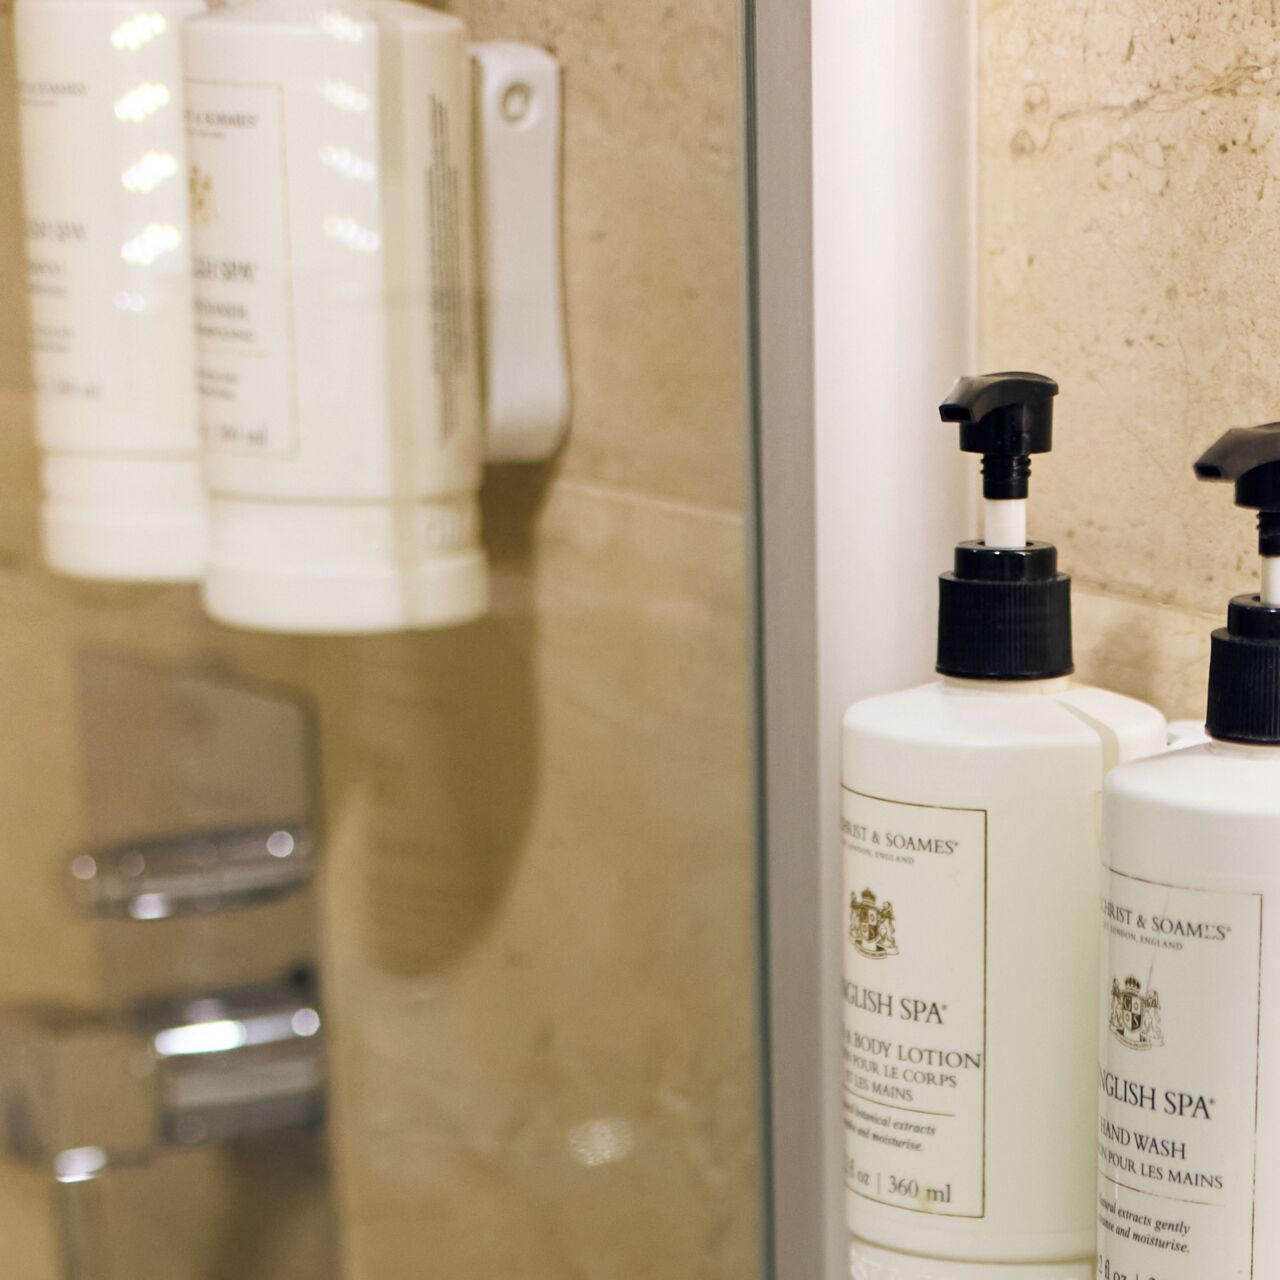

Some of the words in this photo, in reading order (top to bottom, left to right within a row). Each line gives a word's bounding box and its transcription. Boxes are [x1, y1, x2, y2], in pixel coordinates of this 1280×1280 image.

[1136, 914, 1146, 930] &
[1139, 934, 1183, 950] ENGLAND
[854, 1031, 891, 1058] BODY
[897, 1044, 982, 1069] LOTION
[852, 1054, 879, 1075] POUR
[884, 1063, 899, 1080] LE
[902, 1068, 957, 1089] CORPS
[871, 1081, 913, 1102] MAINS
[893, 1119, 936, 1136] extracts
[1100, 1117, 1131, 1146] HAND
[1133, 1132, 1185, 1160] WASH
[1108, 1149, 1136, 1174] POUR
[1140, 1162, 1163, 1181] LES
[1168, 1168, 1223, 1190] MAINS
[857, 1170, 870, 1186] oz
[888, 1174, 919, 1198] 360
[926, 1183, 951, 1203] ml
[1117, 1207, 1151, 1226] extracts
[1154, 1218, 1190, 1237] gently
[1115, 1226, 1131, 1239] and
[1132, 1233, 1190, 1253] moisturise.
[1104, 1259, 1110, 1280] fl
